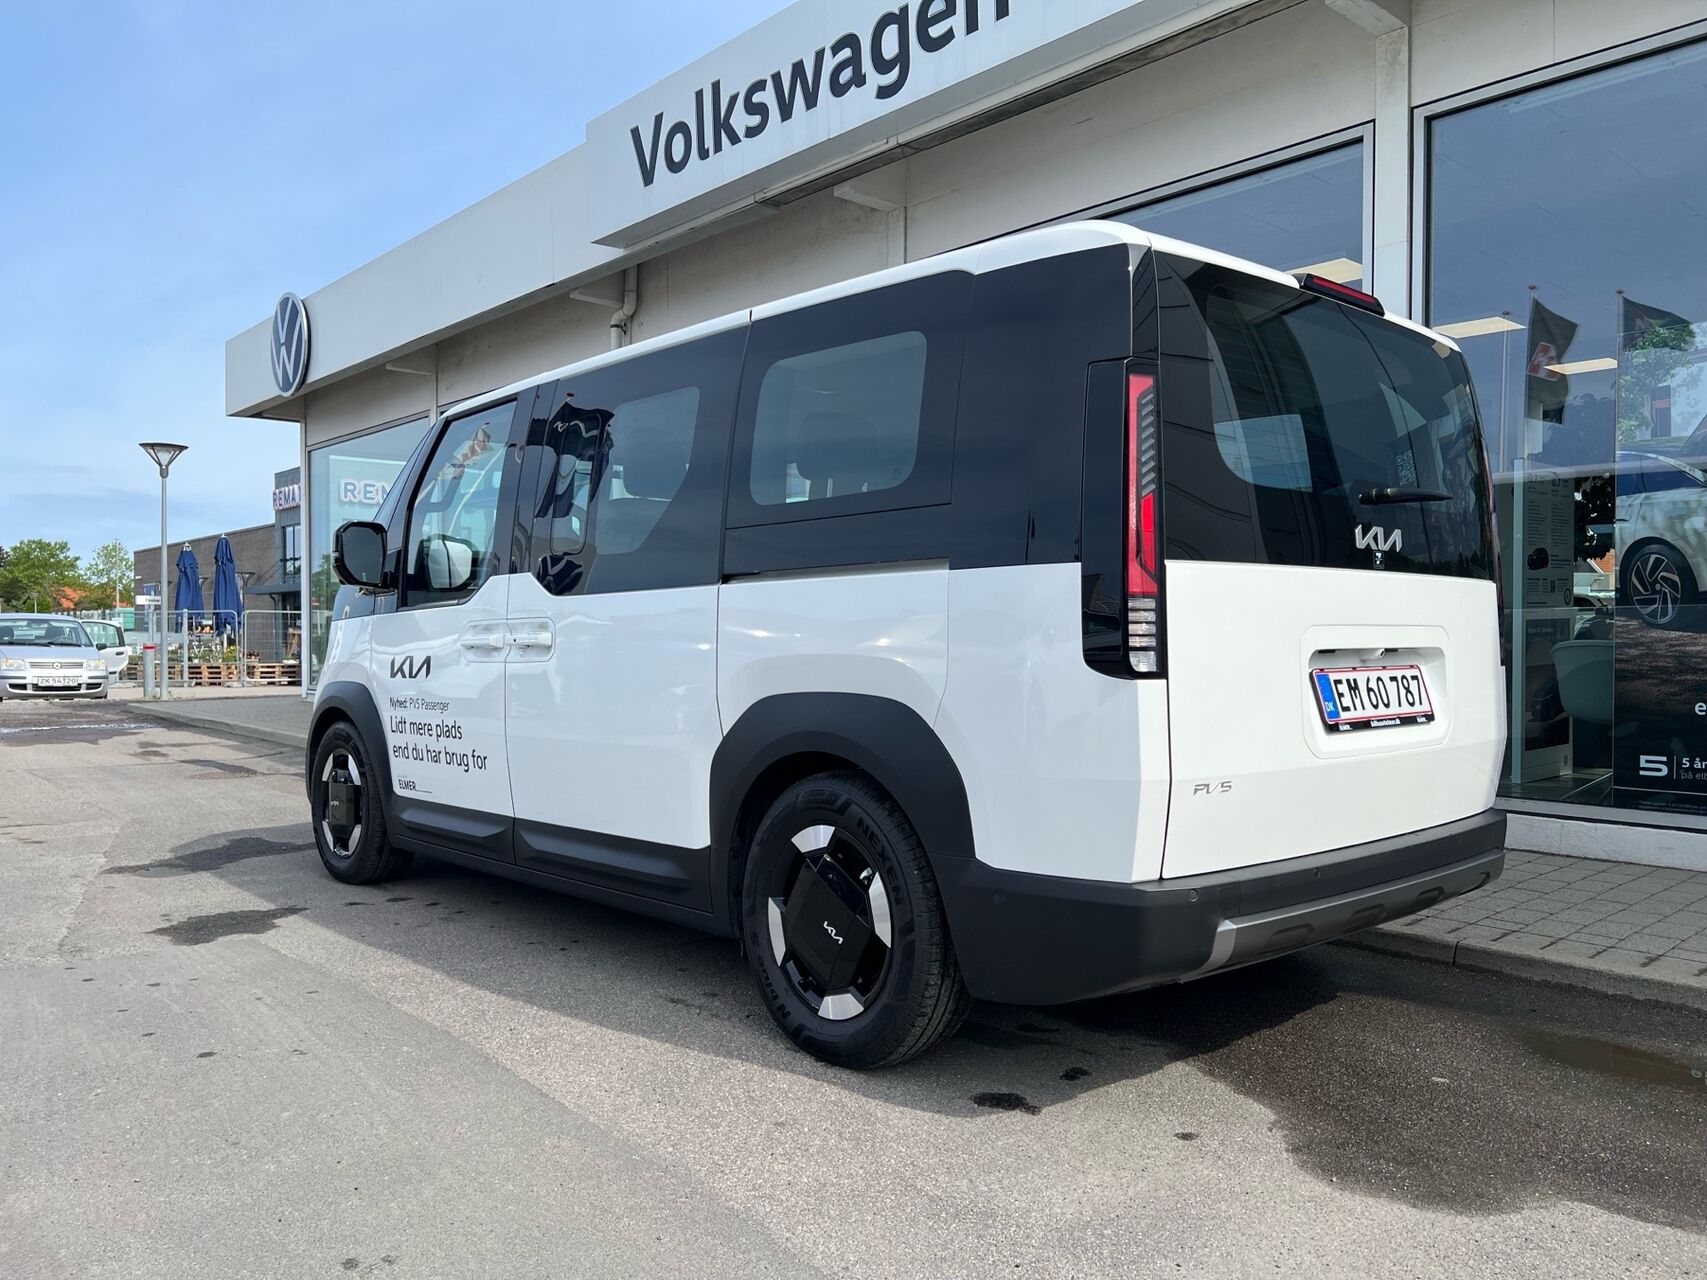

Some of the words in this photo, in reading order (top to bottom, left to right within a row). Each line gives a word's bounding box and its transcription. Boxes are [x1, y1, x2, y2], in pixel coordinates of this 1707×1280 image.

[1355, 524, 1403, 553] KIA
[390, 655, 431, 679] KIA
[389, 697, 409, 711] Nyhed:
[420, 698, 450, 714] Passenger
[1333, 677, 1366, 713] EM
[1366, 675, 1391, 710] 60
[1389, 674, 1424, 708] 787
[1325, 701, 1336, 712] DK
[390, 715, 407, 734] Lidt
[409, 720, 433, 737] mere
[435, 720, 463, 743] plads
[392, 742, 410, 760] end
[412, 742, 424, 762] du
[426, 744, 442, 764] har
[444, 746, 470, 773] brug
[471, 748, 488, 771] for
[1681, 757, 1690, 768] 5
[398, 779, 417, 792] ELMER
